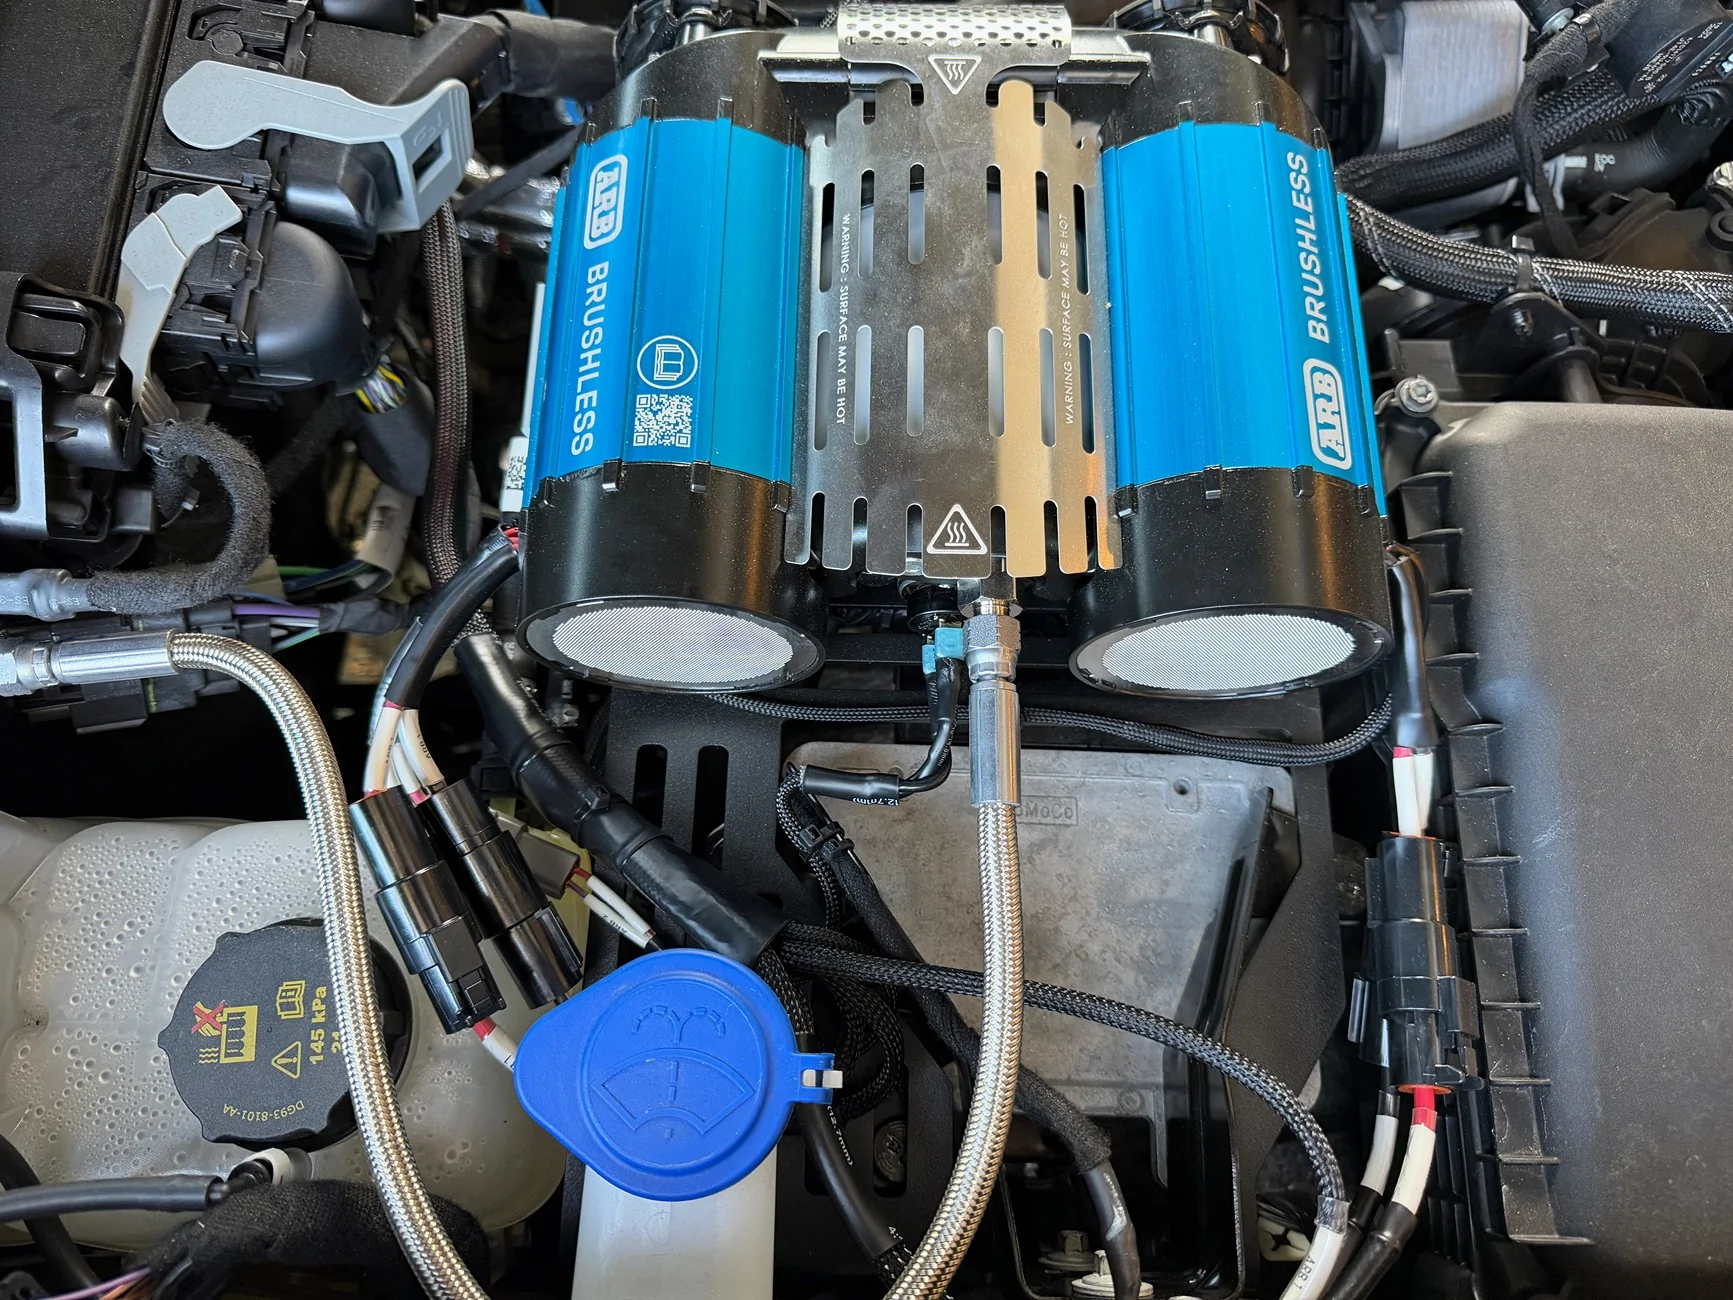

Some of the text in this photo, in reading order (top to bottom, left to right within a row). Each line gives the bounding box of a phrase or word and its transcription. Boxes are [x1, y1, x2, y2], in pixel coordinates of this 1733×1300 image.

[840, 213, 851, 274] WARNING
[1058, 213, 1069, 239] HOT
[1287, 151, 1330, 344] BRUSHLESS
[1060, 241, 1069, 257] BE
[1060, 260, 1070, 289] MAY
[838, 285, 849, 342] SURFACE
[1061, 292, 1072, 349] SURFACE
[571, 261, 610, 456] BRUSHLESS
[837, 345, 847, 374] MAY
[836, 378, 847, 395] BE
[1063, 361, 1074, 425] WARNING
[836, 397, 846, 425] HOT
[1312, 371, 1345, 459] ARB
[1015, 801, 1074, 820] oMoCo
[309, 986, 327, 1065] 145 kPa
[223, 1100, 305, 1122] DG93-8101-AA
